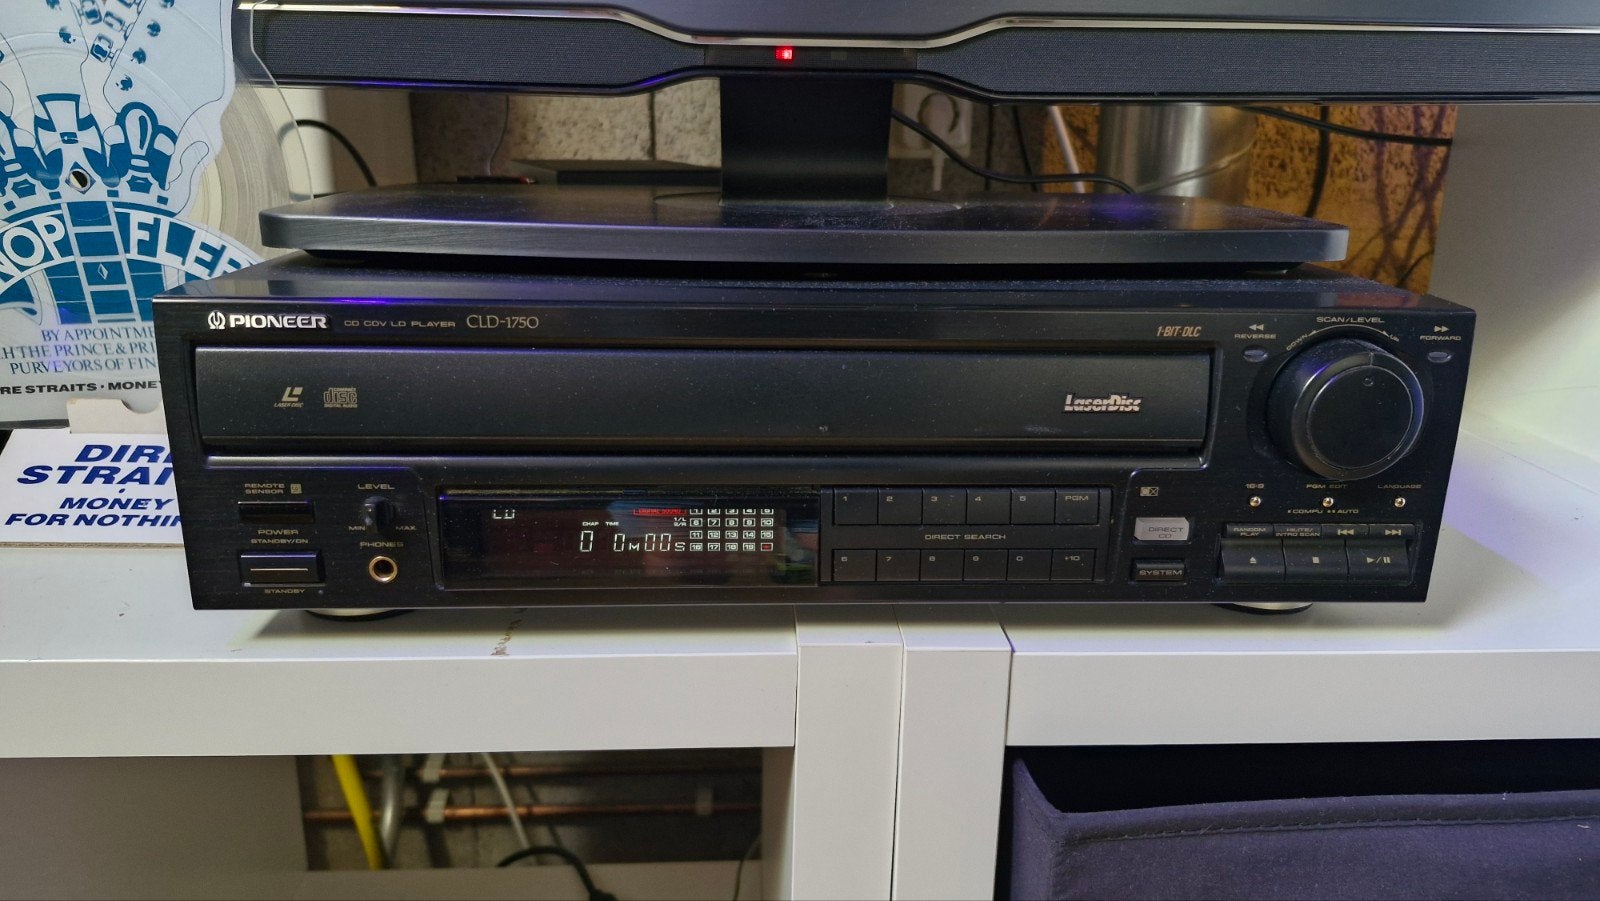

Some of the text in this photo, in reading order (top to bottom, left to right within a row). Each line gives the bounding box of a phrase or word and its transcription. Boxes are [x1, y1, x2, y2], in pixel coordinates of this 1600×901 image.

[230, 314, 328, 329] PIONEER
[466, 314, 540, 329] CLD-1750
[41, 330, 61, 342] BY
[1286, 334, 1308, 351] DOWN
[16, 345, 51, 358] THE
[54, 342, 114, 357] PRINCE
[116, 343, 127, 354] &
[10, 360, 102, 375] PURVEYORS
[104, 358, 125, 372] OF
[26, 383, 97, 394] STRAITS
[108, 380, 160, 390] MONE
[1064, 394, 1142, 412] LaserDisc
[59, 498, 175, 510] MONEY
[4, 514, 70, 526] FOR
[580, 530, 594, 552] 0
